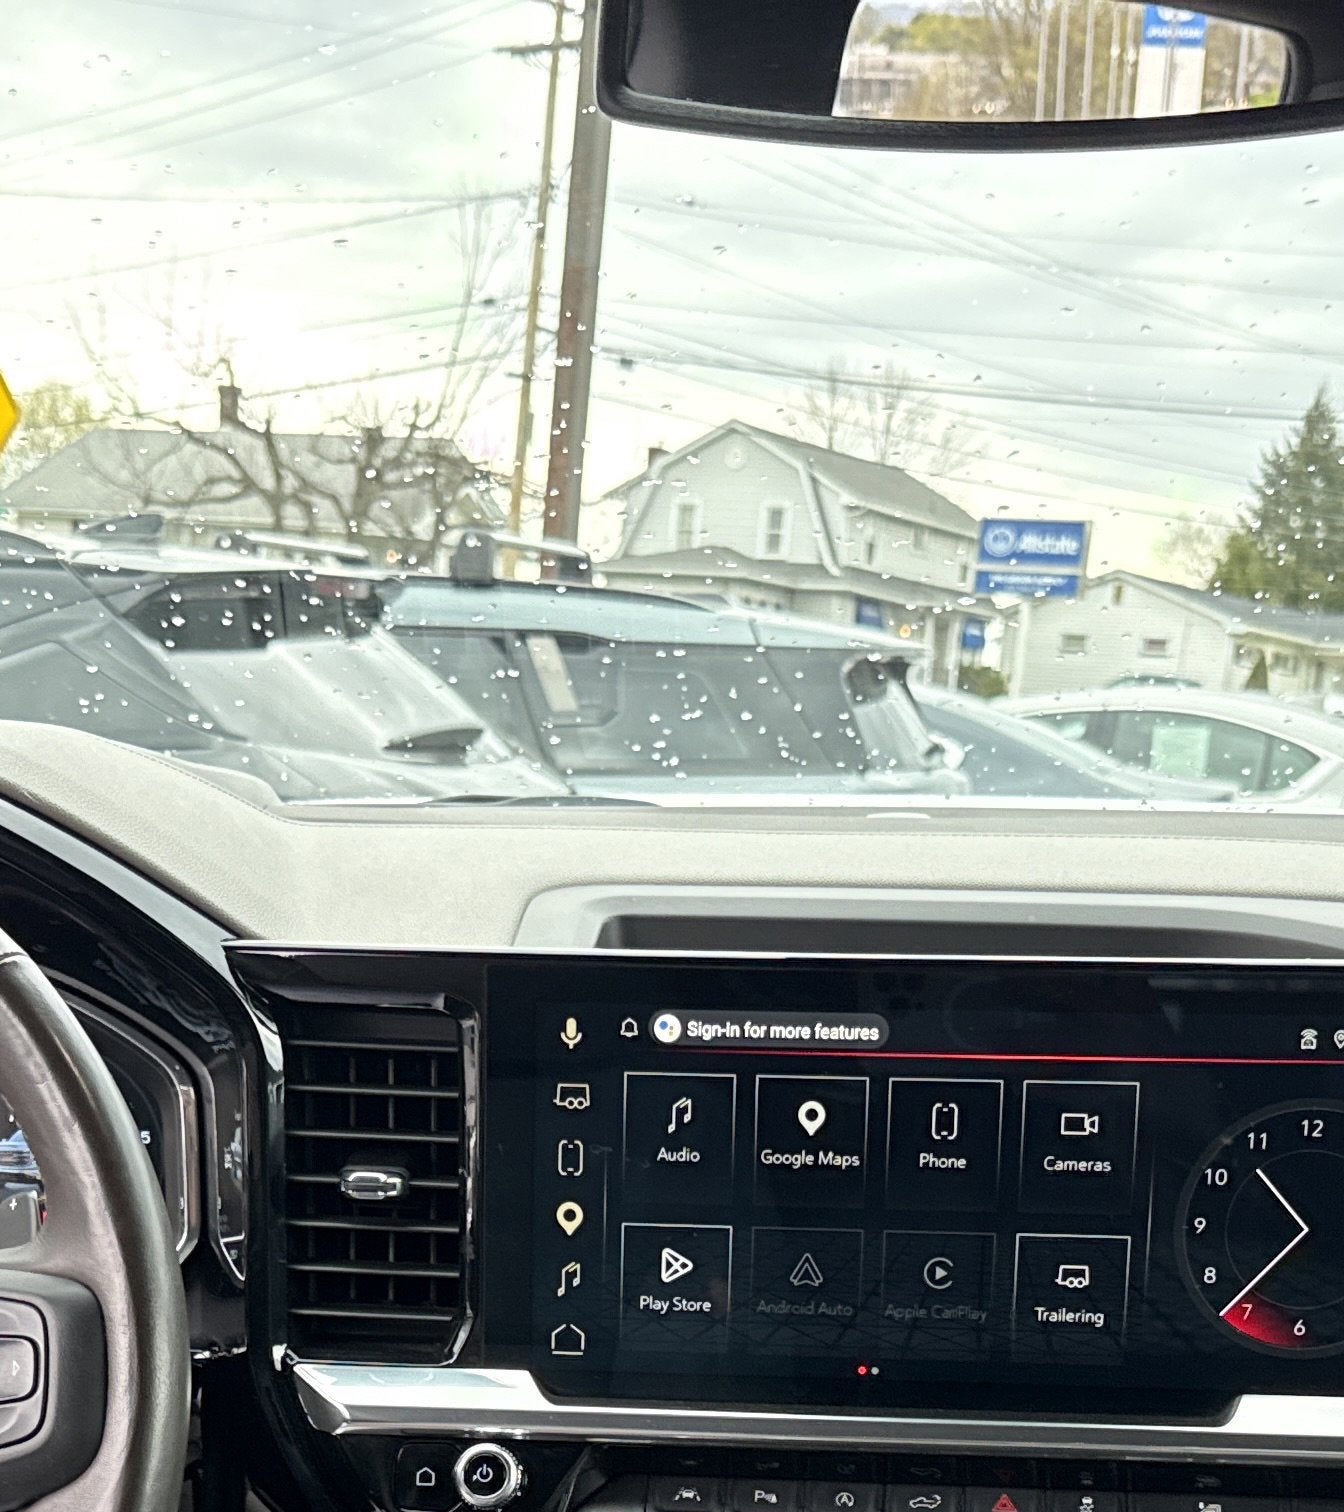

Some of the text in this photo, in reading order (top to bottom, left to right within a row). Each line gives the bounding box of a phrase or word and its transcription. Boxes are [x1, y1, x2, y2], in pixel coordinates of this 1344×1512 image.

[686, 1021, 880, 1041] Sign-in for more features
[140, 1130, 152, 1145] 5
[1301, 1119, 1324, 1138] 12
[1247, 1132, 1268, 1150] 11
[656, 1146, 700, 1163] Audio
[760, 1149, 860, 1171] Google Maps
[919, 1152, 967, 1170] Phone
[1043, 1155, 1112, 1173] Cameras
[1204, 1168, 1229, 1186] 10
[1194, 1217, 1206, 1234] 9
[1203, 1266, 1217, 1284] 8
[639, 1296, 712, 1314] Play Store
[757, 1299, 853, 1317] Android Auto
[884, 1304, 928, 1321] Apple
[1241, 1303, 1253, 1321] 7
[1034, 1307, 1105, 1327] Trailering
[1293, 1319, 1306, 1337] 6
